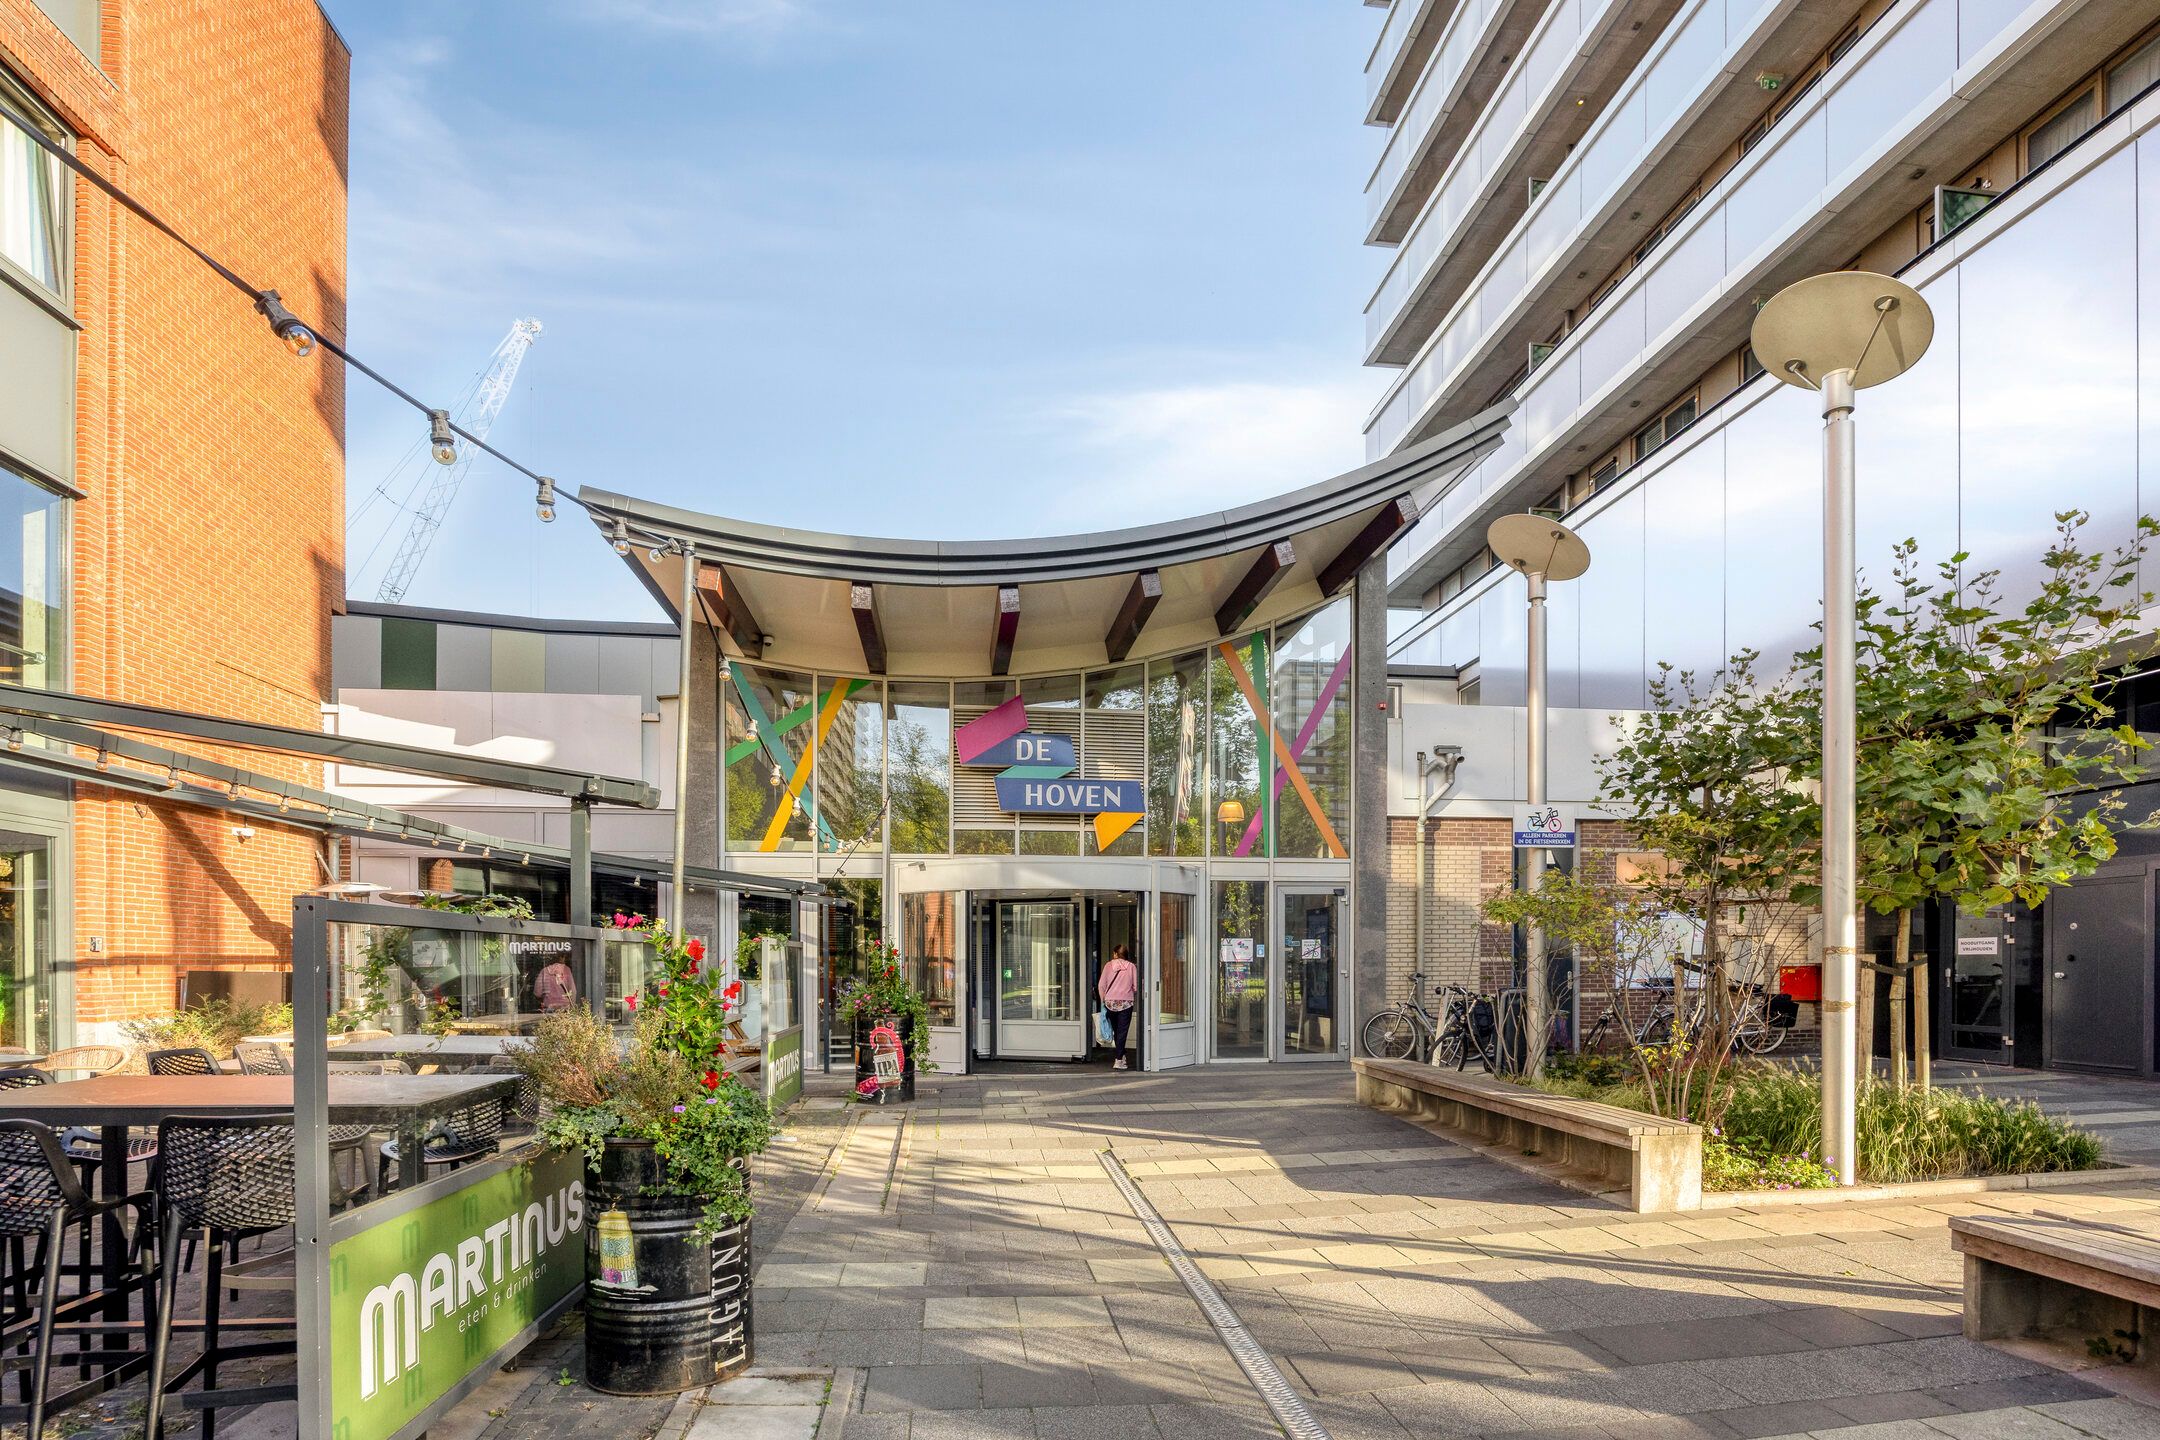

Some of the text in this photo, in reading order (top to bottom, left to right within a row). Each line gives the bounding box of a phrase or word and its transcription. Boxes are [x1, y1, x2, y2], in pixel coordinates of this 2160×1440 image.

[1016, 738, 1052, 761] DE
[1025, 783, 1121, 808] HOVEN
[509, 941, 572, 954] MARTINUS
[708, 1156, 748, 1373] LAGUNIS
[360, 1180, 584, 1402] MARTINUS
[459, 1263, 547, 1333] eten & drinken
